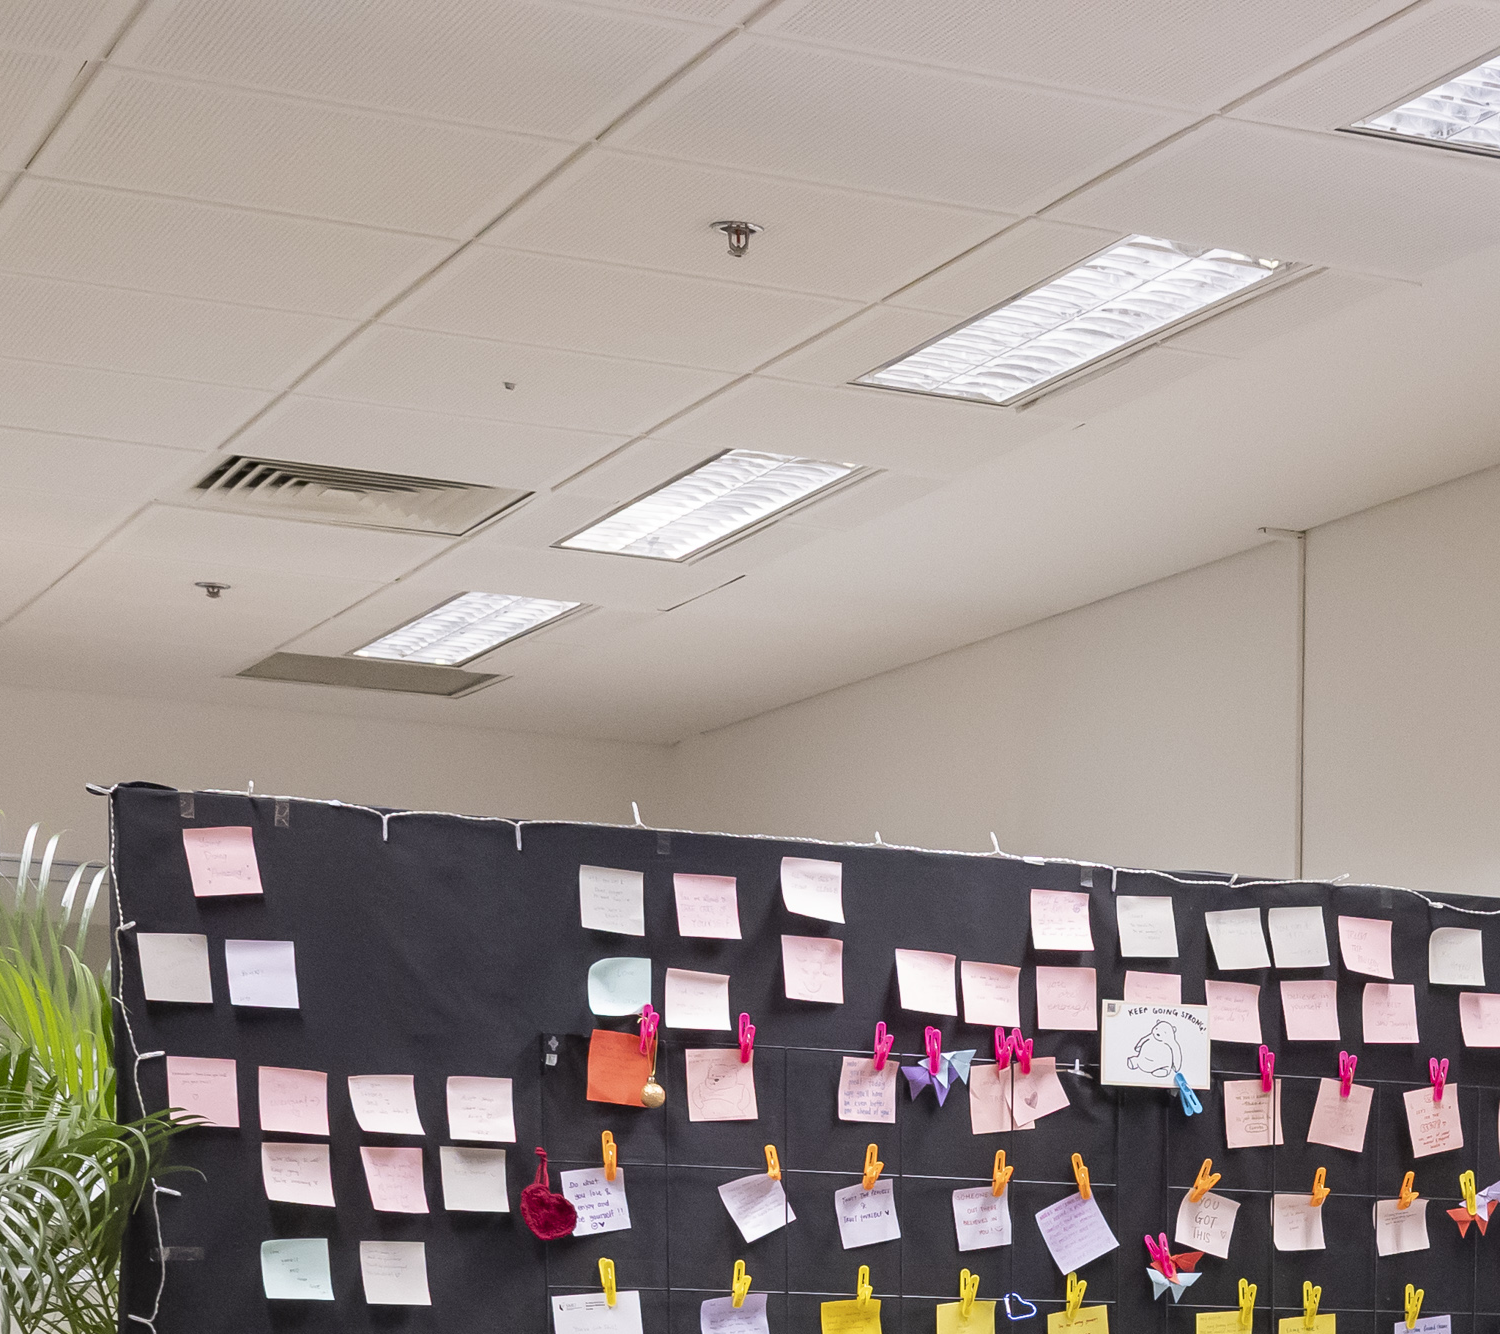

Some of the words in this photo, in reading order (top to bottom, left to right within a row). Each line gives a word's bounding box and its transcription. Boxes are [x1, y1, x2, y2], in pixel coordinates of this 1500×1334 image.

[1128, 1007, 1149, 1018] KEEP
[1152, 1007, 1179, 1018] GOING
[1180, 1010, 1207, 1035] STRONG!
[583, 1178, 599, 1187] what
[577, 1203, 594, 1211] enjoy
[1198, 1198, 1220, 1210] YOU
[589, 1211, 615, 1222] yourself
[1194, 1211, 1218, 1229] GOT
[1192, 1226, 1212, 1243] THIS
